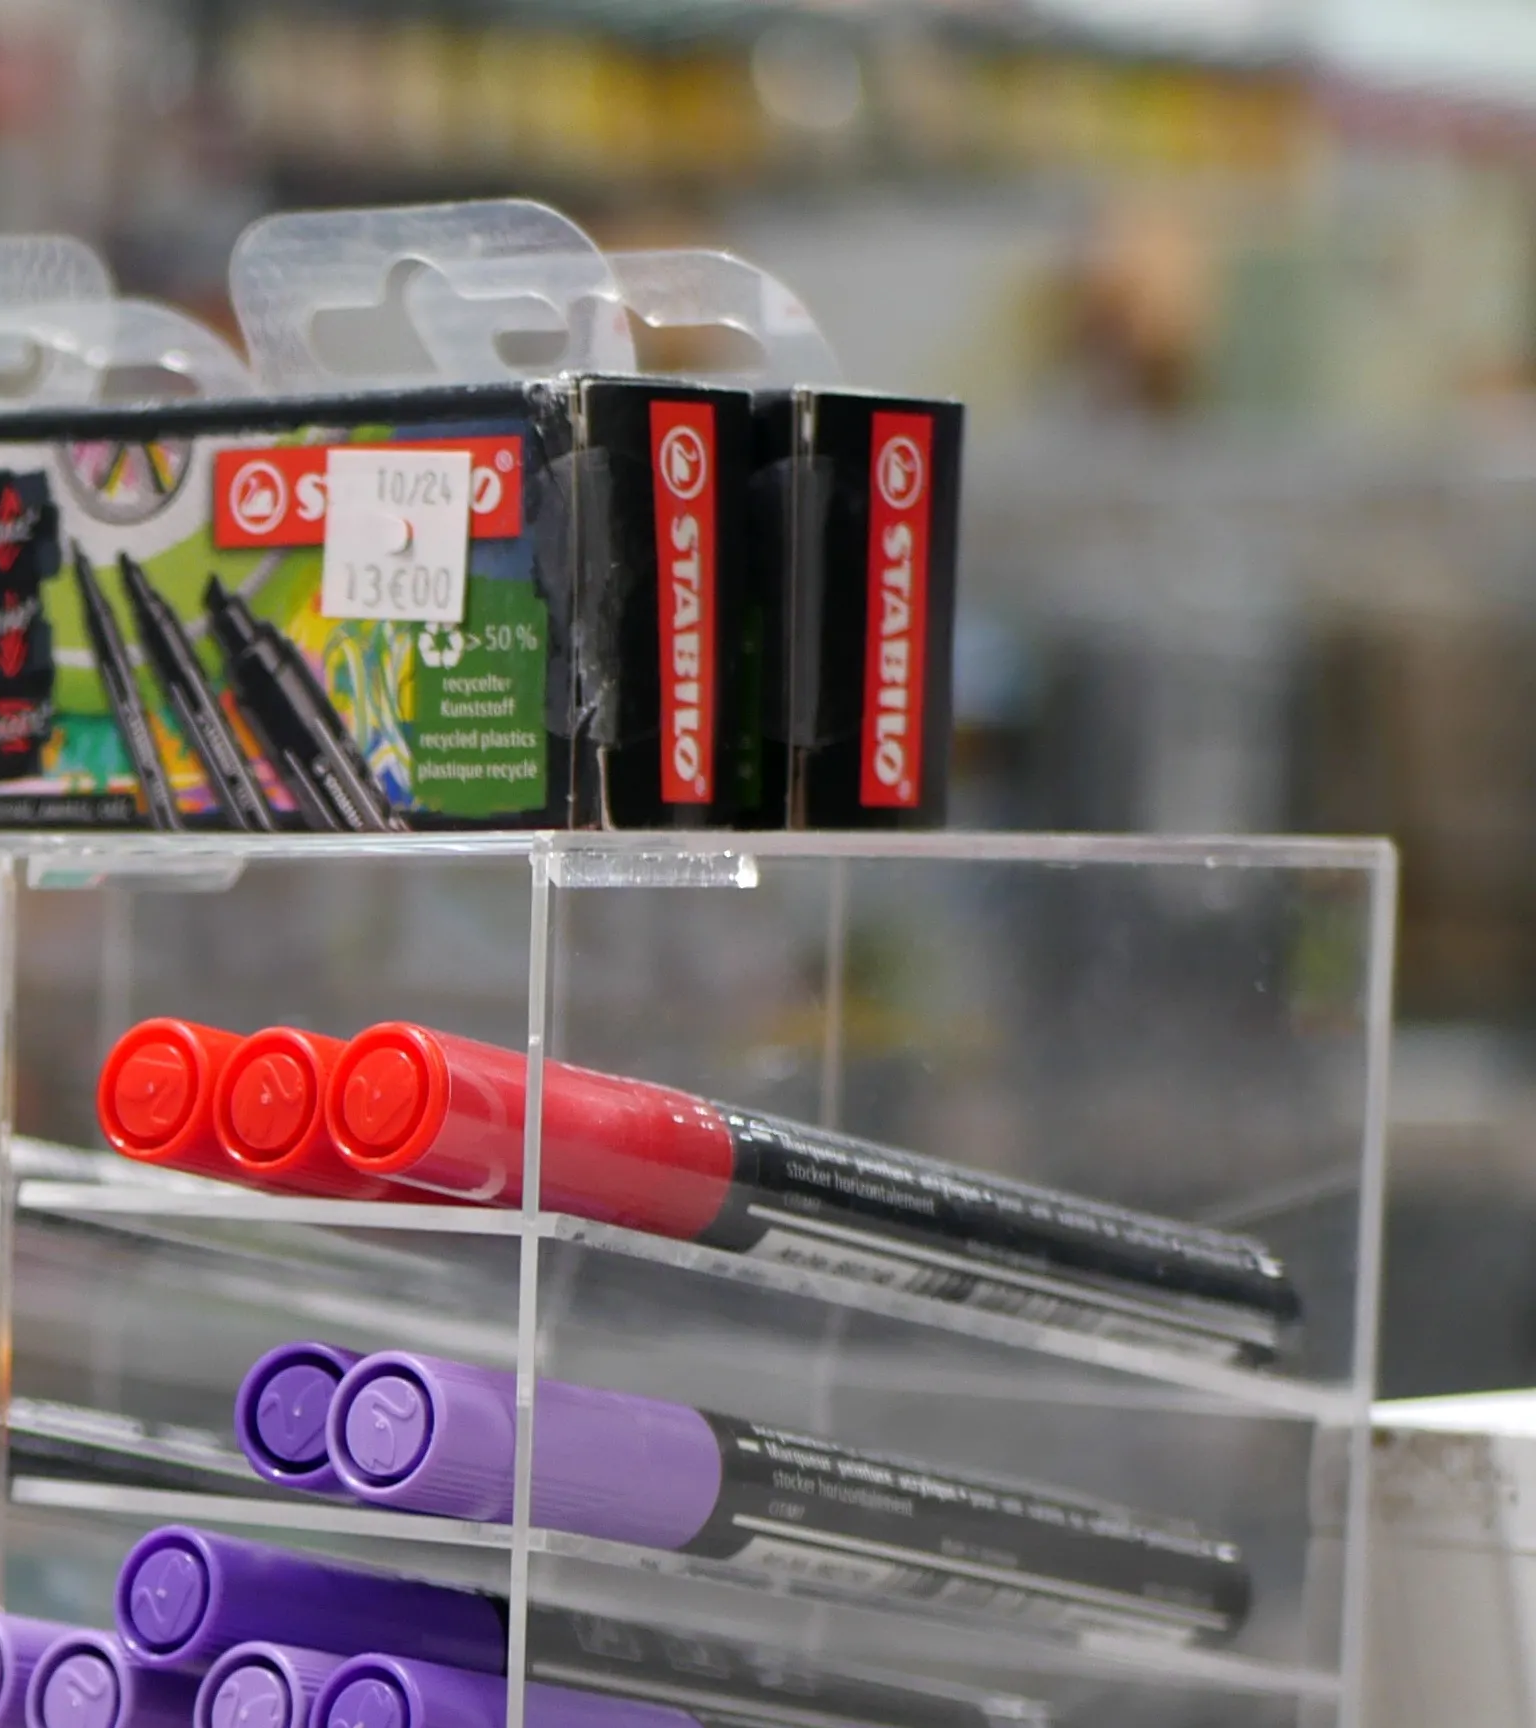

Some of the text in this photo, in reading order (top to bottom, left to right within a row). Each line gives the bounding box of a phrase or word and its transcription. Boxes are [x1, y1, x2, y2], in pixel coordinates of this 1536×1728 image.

[377, 466, 453, 507] 10/24
[671, 513, 703, 783] STABILO
[873, 522, 913, 788] STABILO
[440, 697, 516, 719] Kunststoff
[419, 728, 537, 752] recycled plastics
[418, 758, 538, 784] plastique recyclé
[786, 1159, 831, 1189] stocker
